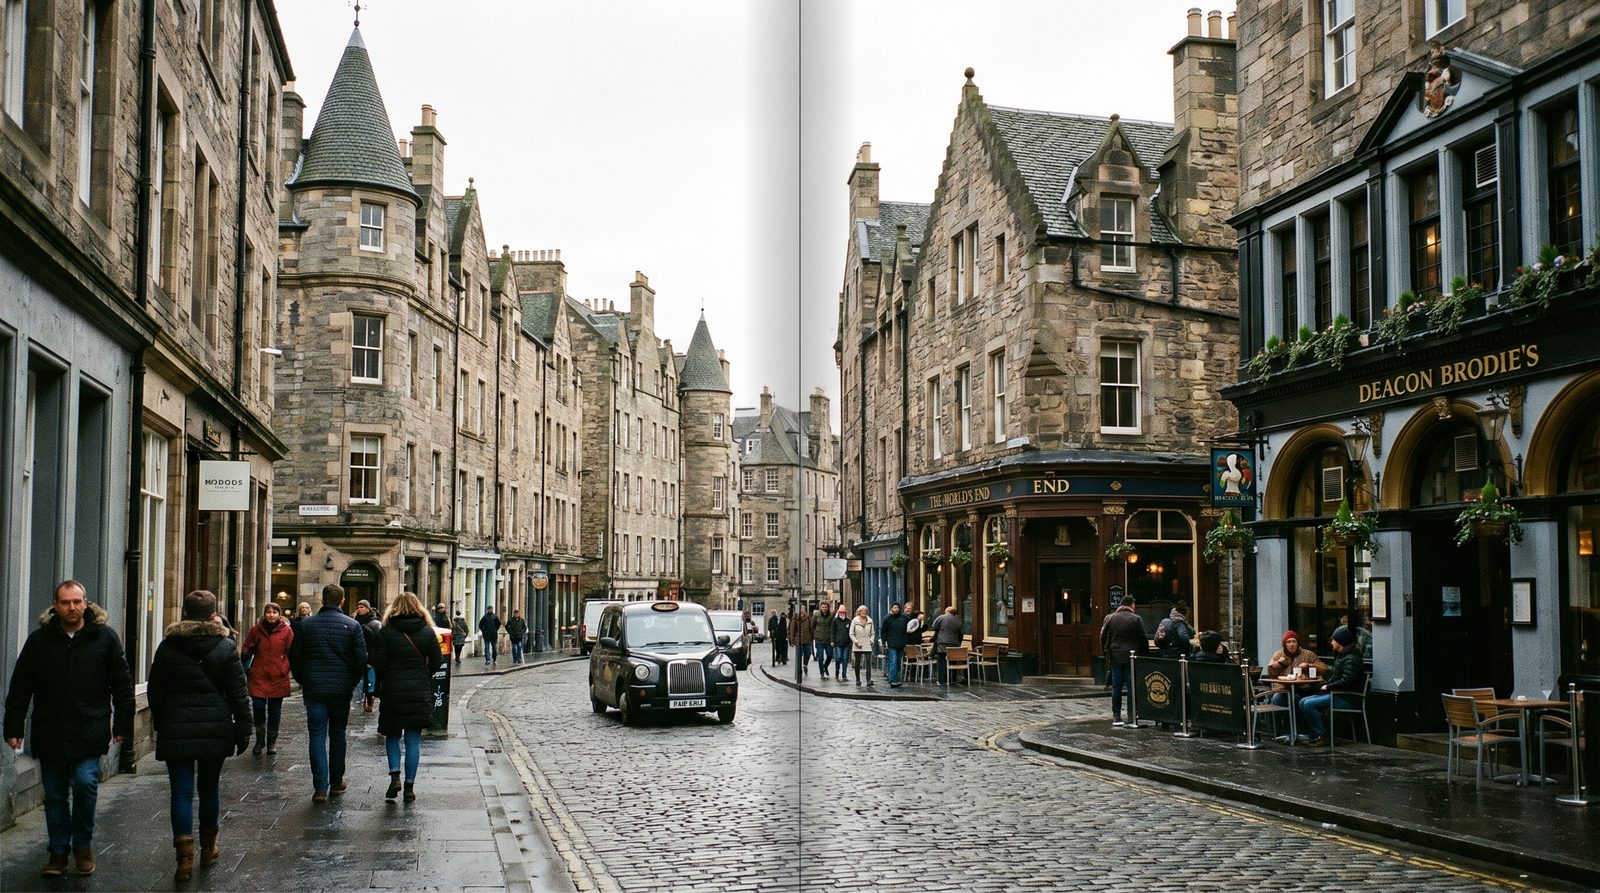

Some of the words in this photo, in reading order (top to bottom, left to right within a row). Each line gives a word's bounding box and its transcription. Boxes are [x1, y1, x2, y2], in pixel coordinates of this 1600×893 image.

[1359, 368, 1433, 404] DEACON
[1440, 344, 1540, 386] BRODIE'S
[929, 495, 942, 509] THE
[943, 490, 973, 508] WORLD'S
[975, 486, 990, 501] END
[1033, 479, 1070, 494] END
